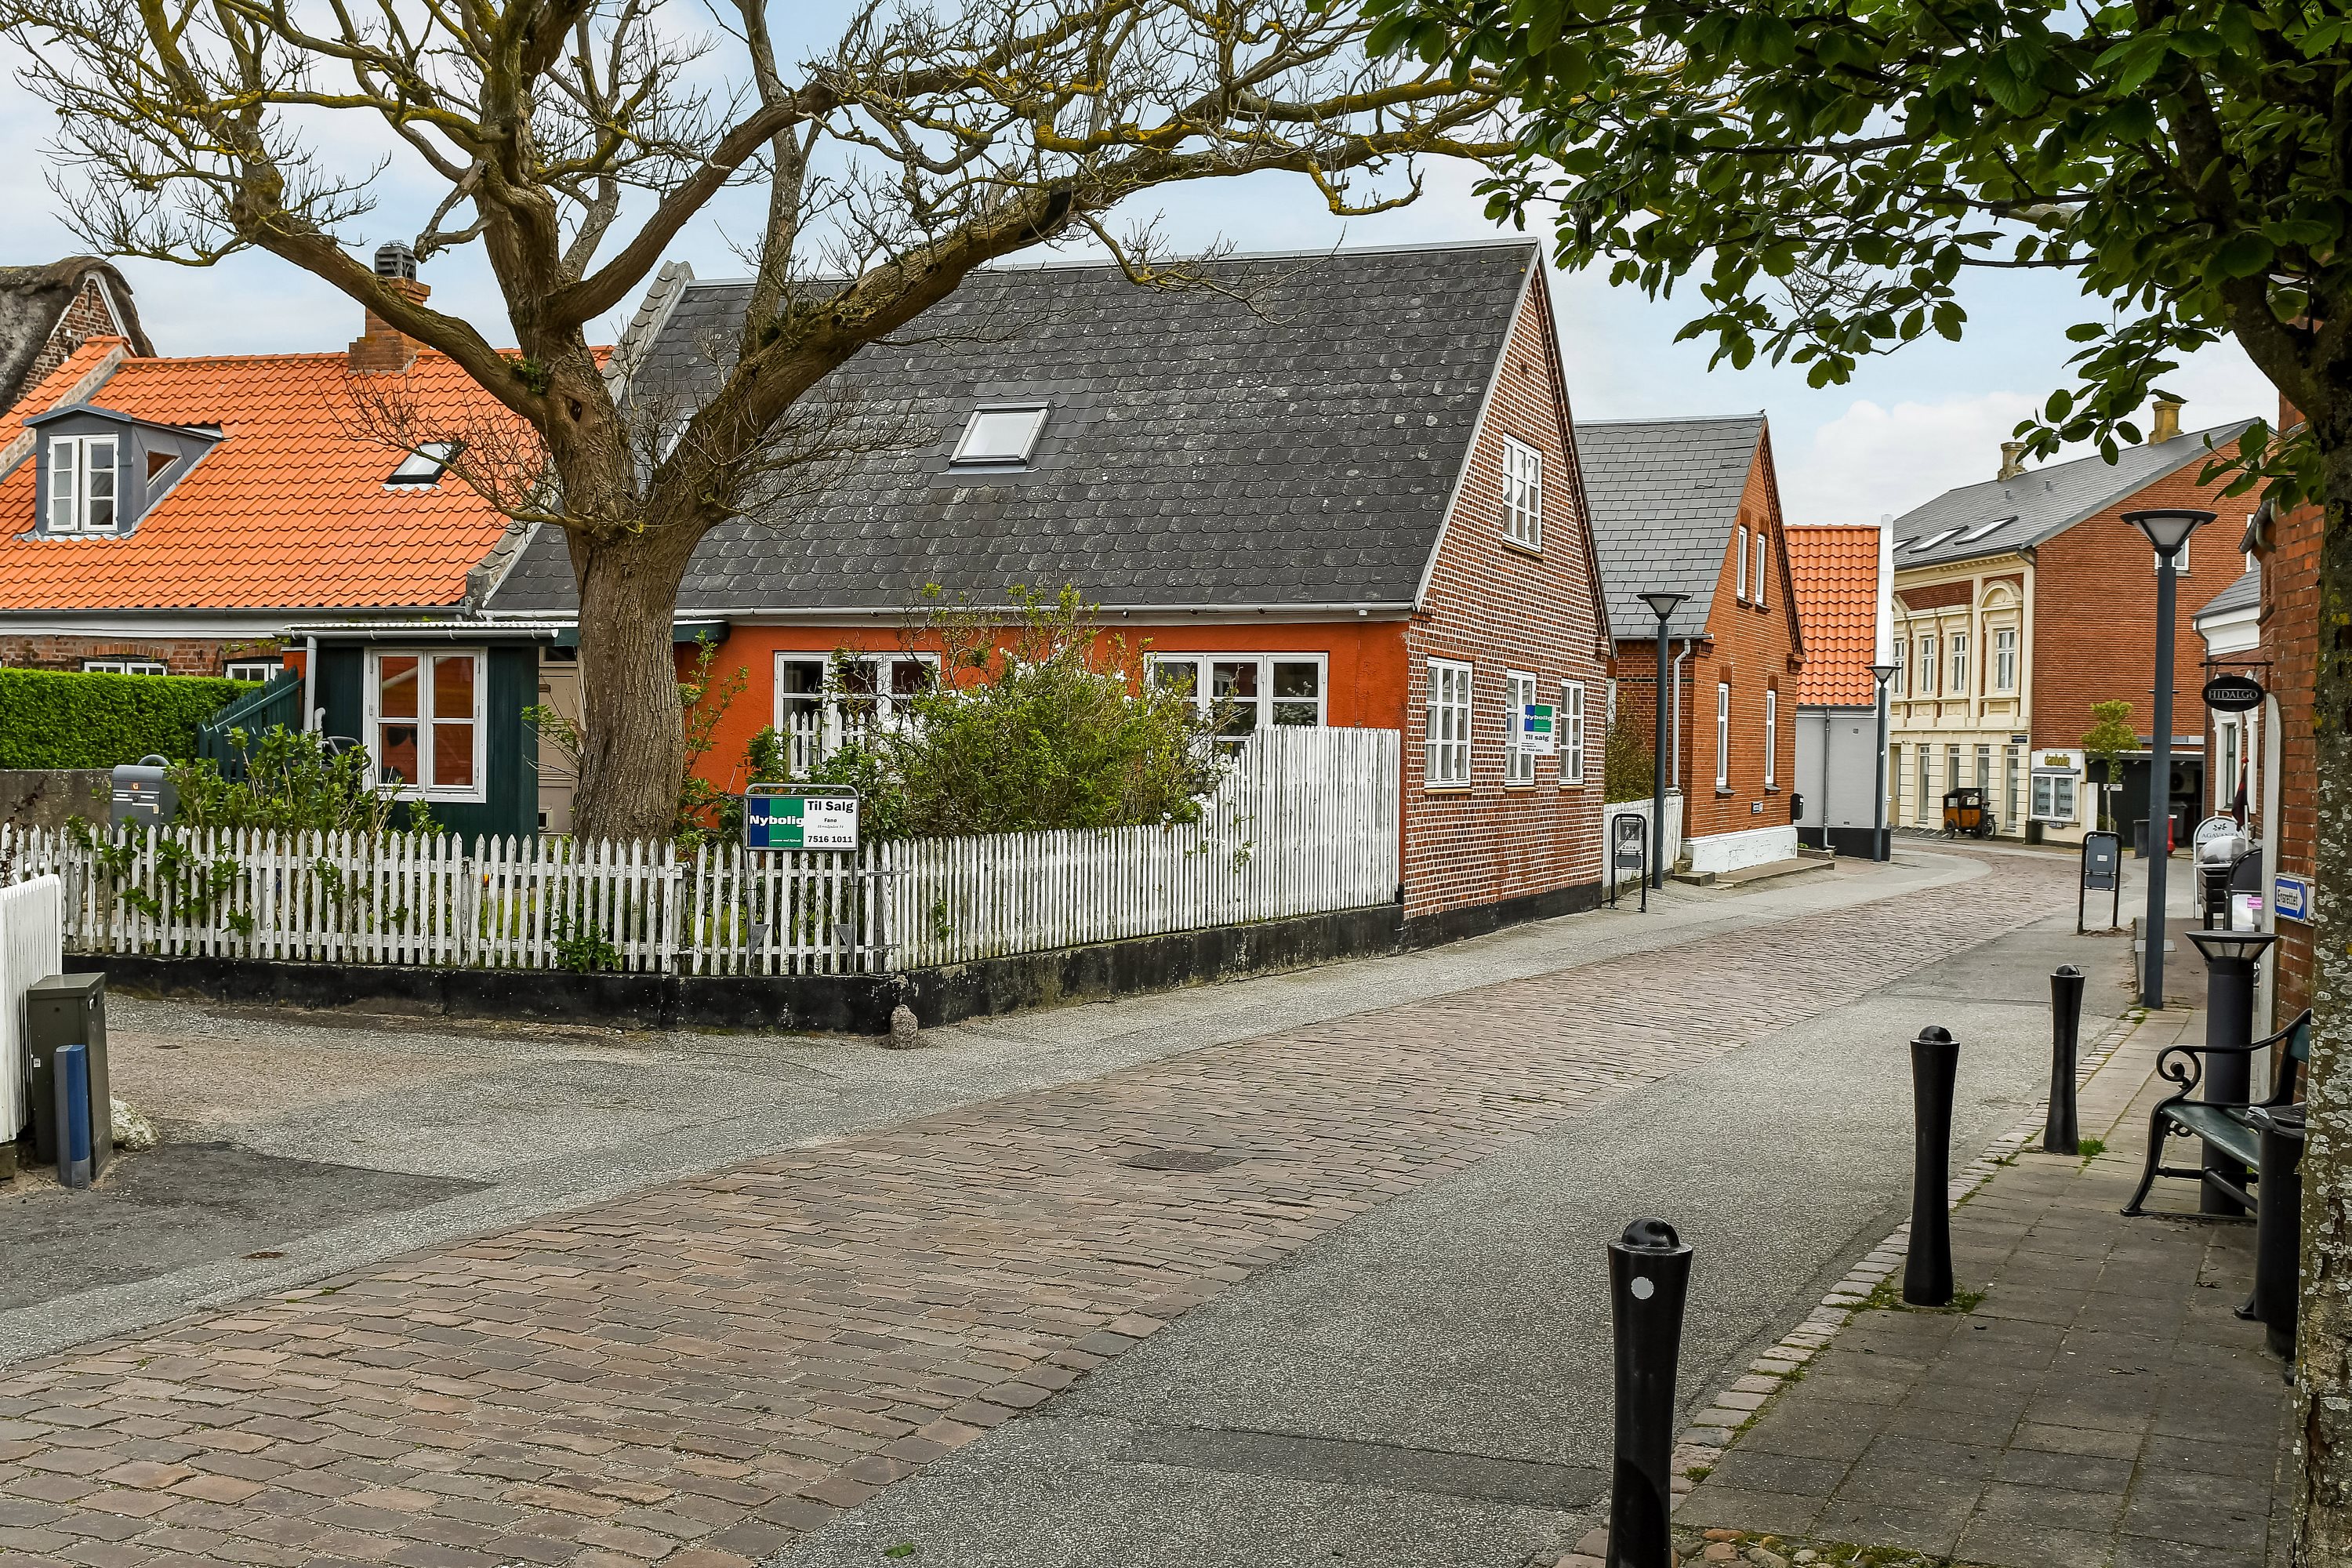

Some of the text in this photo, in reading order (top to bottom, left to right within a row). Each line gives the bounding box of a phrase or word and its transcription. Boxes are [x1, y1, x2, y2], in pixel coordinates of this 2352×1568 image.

[2209, 690, 2258, 699] HIDALGO
[808, 800, 854, 814] Til Salg
[750, 815, 804, 828] Nybolig
[2277, 888, 2299, 906] Ensrettet
